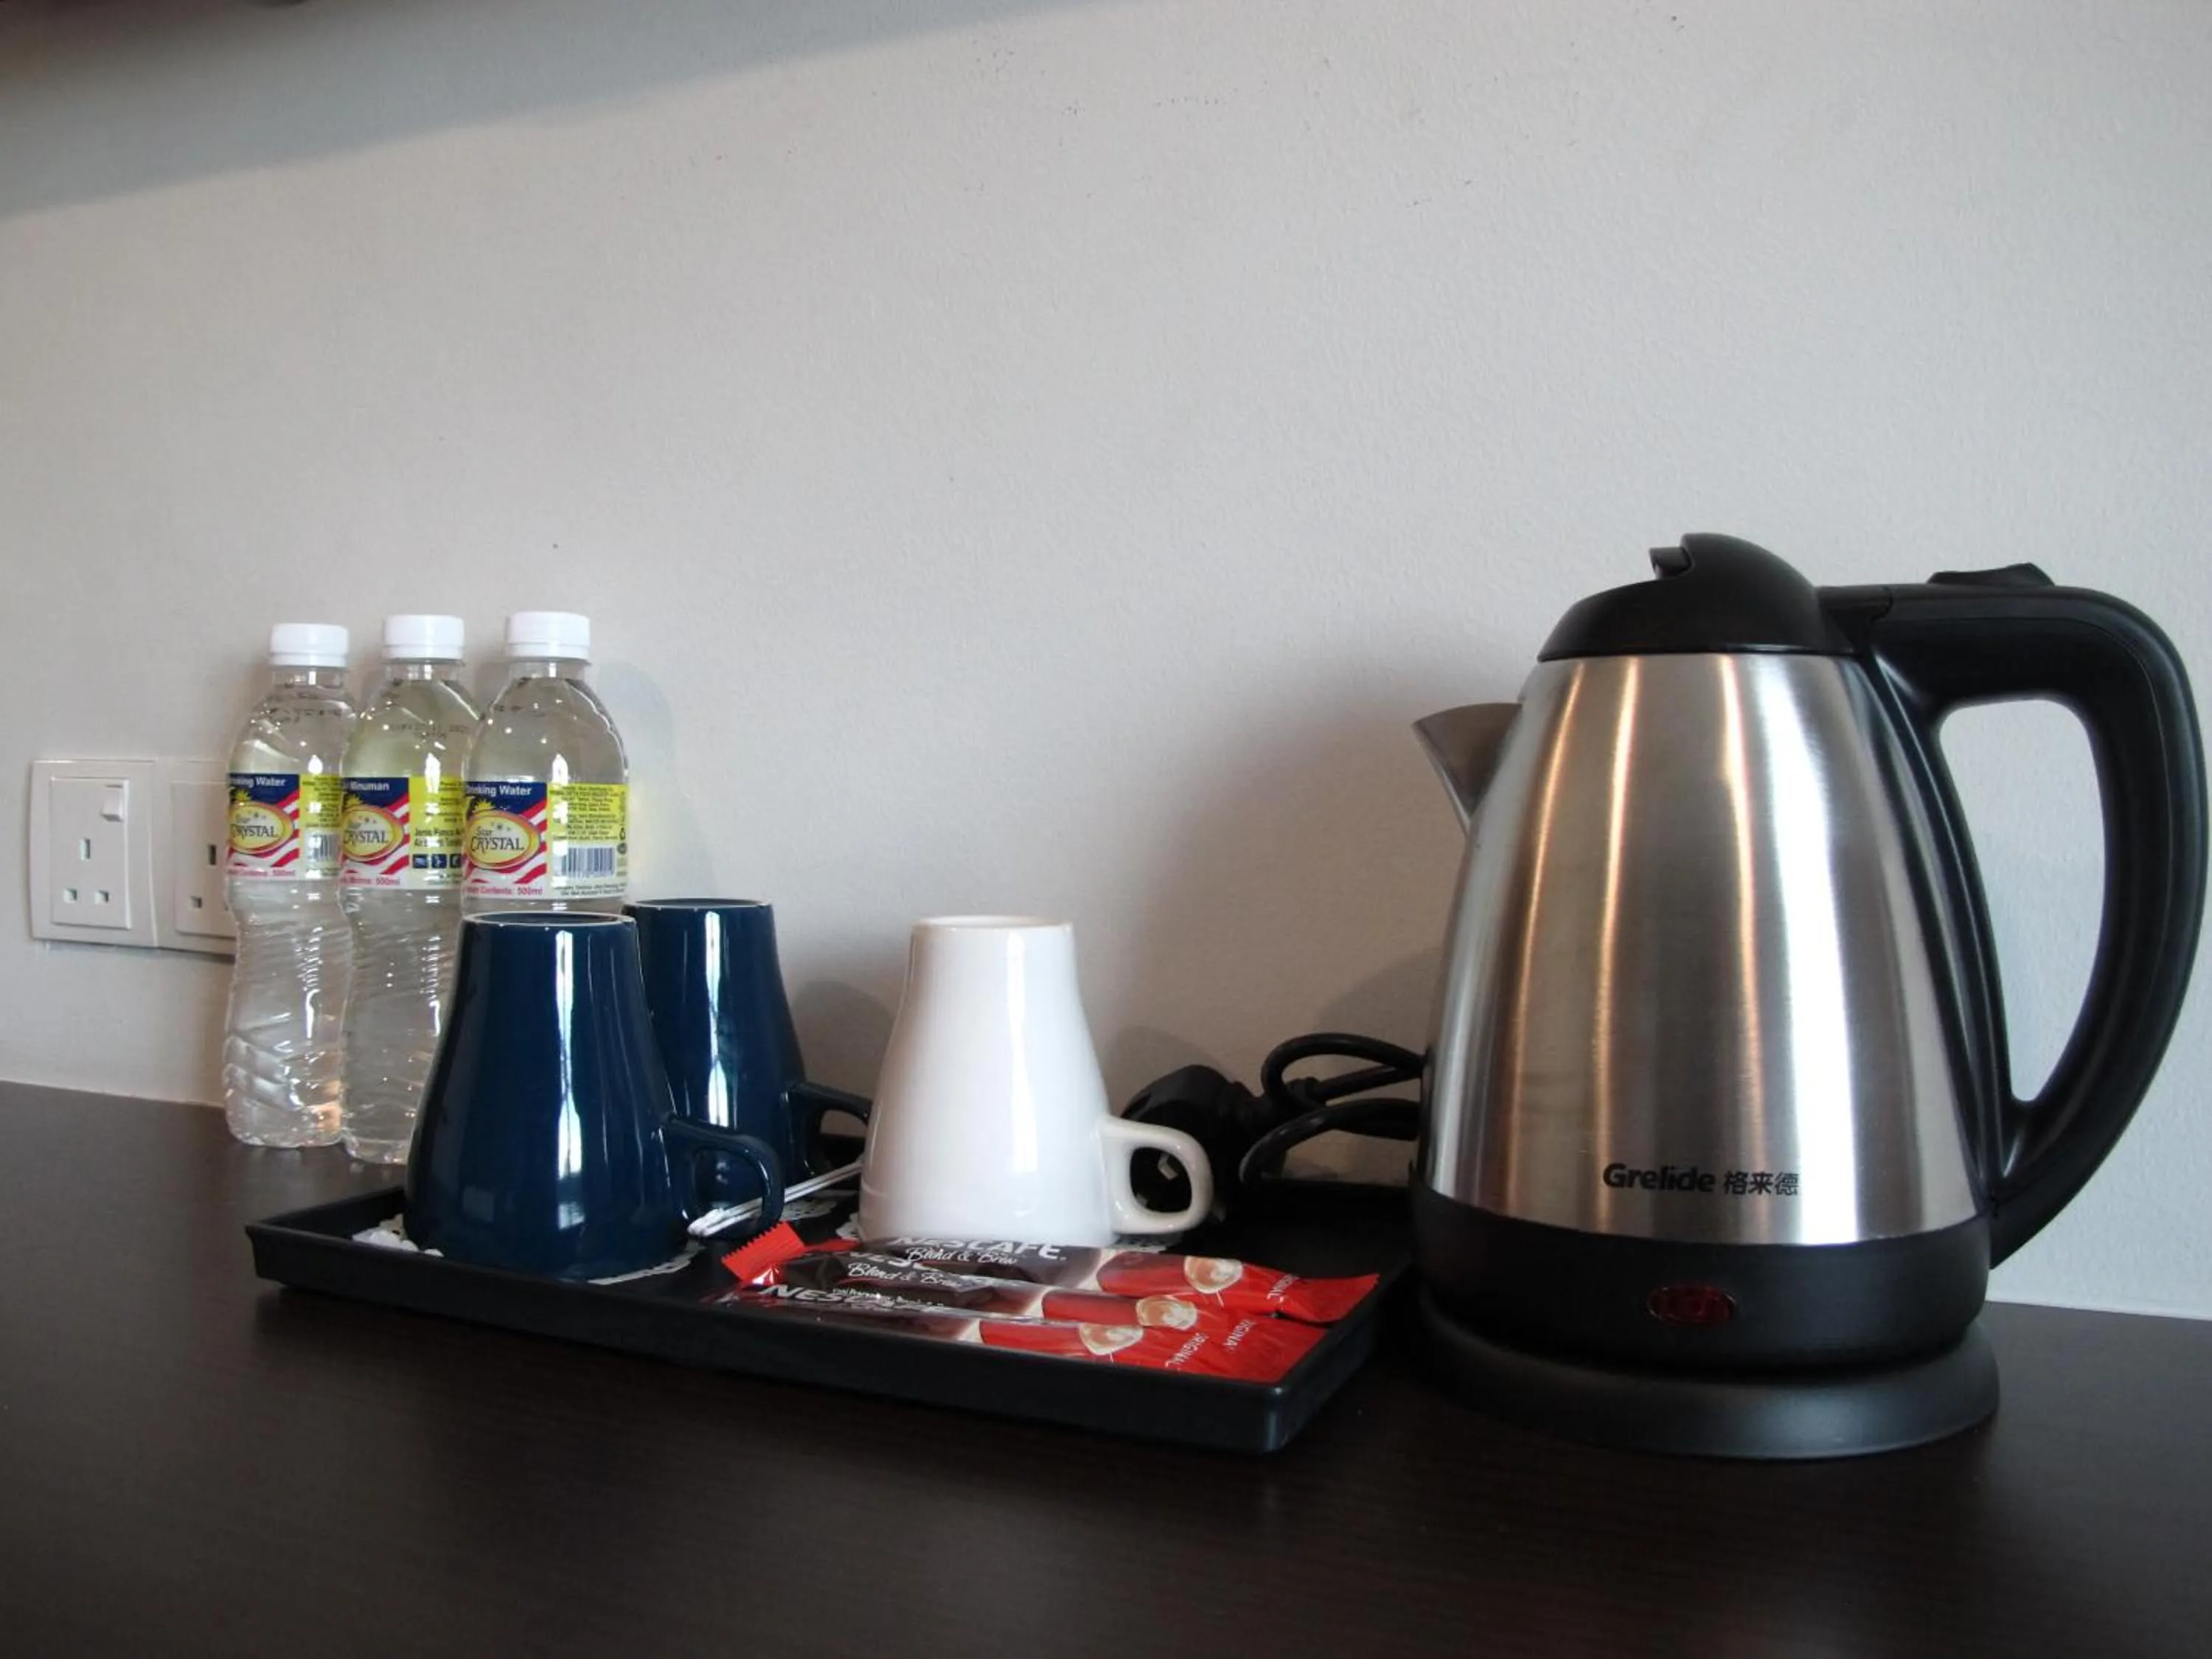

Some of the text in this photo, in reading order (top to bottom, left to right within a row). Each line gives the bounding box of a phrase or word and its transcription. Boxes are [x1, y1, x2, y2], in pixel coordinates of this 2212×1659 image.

[255, 777, 287, 787] Water
[499, 785, 532, 796] Water
[470, 835, 525, 855] CRYSTAL
[1602, 1163, 1716, 1193] Grelide
[1722, 1171, 1800, 1195] 格来德
[848, 1262, 902, 1280] Blend
